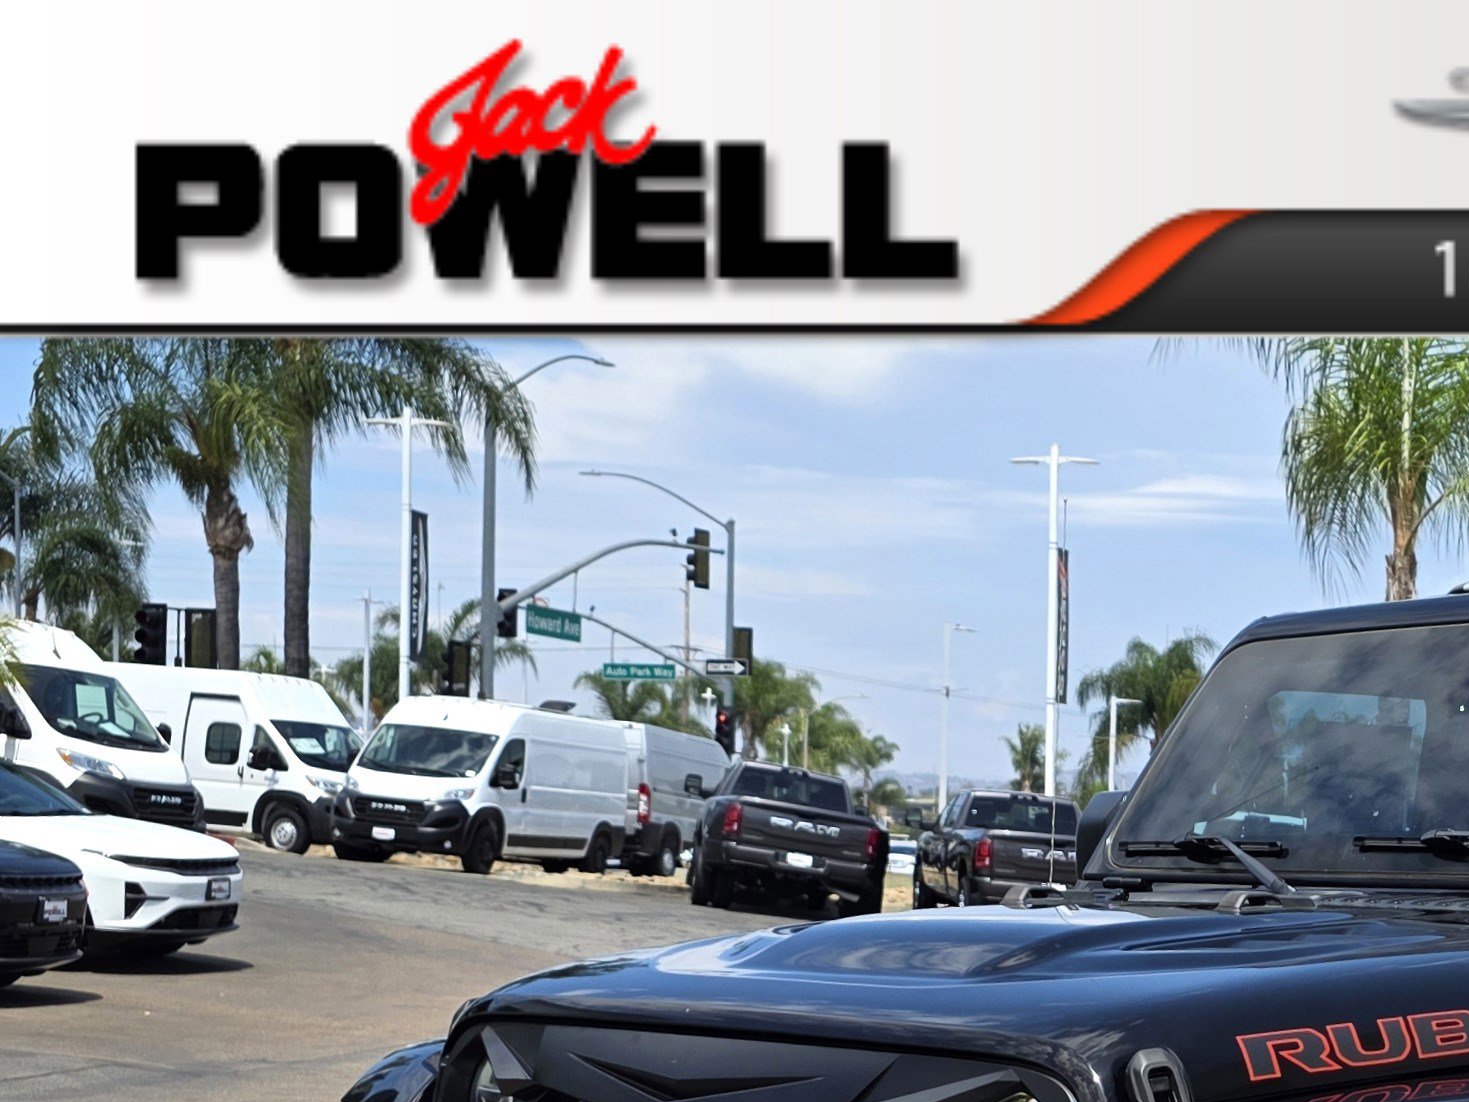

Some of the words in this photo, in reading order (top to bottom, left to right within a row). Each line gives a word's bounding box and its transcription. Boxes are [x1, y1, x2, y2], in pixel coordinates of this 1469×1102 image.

[527, 610, 561, 633] Howard
[564, 615, 581, 636] Ave
[605, 665, 627, 676] Auto
[630, 666, 651, 676] Park
[654, 667, 674, 678] Way
[769, 815, 841, 837] RAM
